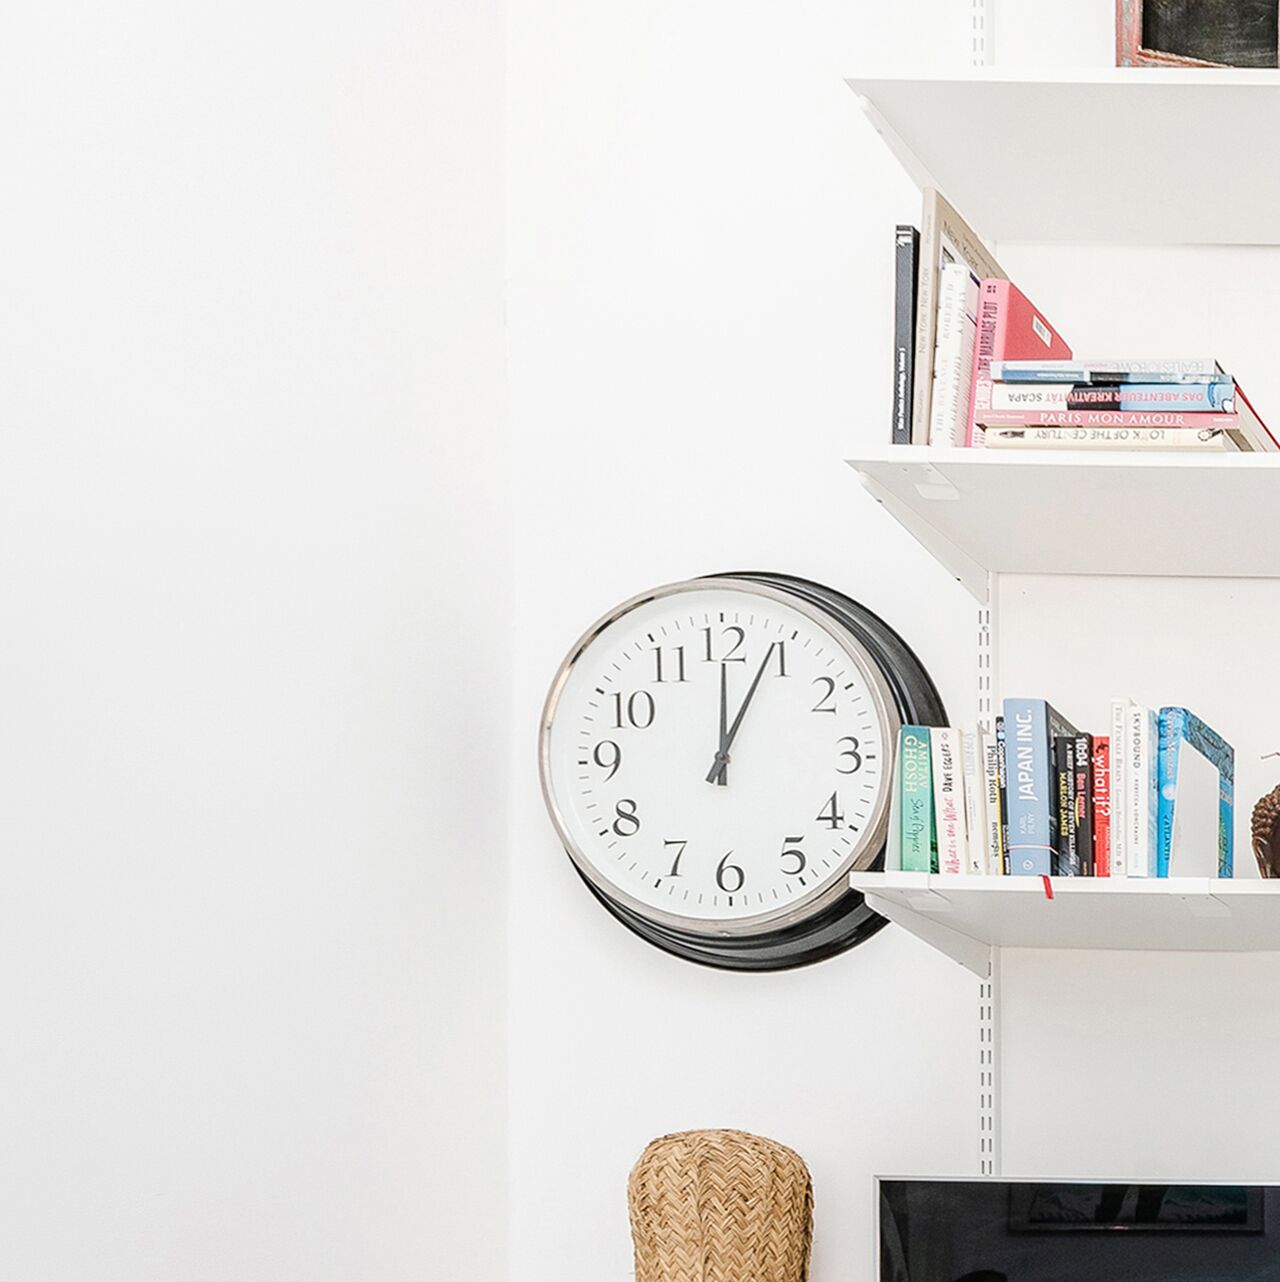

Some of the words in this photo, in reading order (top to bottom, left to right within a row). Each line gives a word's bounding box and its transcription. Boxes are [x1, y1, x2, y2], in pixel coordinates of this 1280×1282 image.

[982, 301, 998, 319] PLOT
[979, 320, 997, 356] MARRIAGE
[1008, 392, 1043, 402] SCAPA
[1115, 391, 1179, 402] ABENTEUER
[1182, 391, 1204, 401] DAS
[1035, 430, 1087, 439] CETURY
[1040, 413, 1081, 422] PARIS
[1088, 413, 1124, 423] MON
[1129, 414, 1185, 424] AMOUR
[1090, 430, 1111, 439] THE
[1132, 430, 1166, 439] LOK
[701, 626, 747, 663] 12
[777, 641, 792, 678] 1
[652, 645, 690, 683] 11
[611, 690, 656, 729] 10
[811, 677, 837, 714] 2
[1015, 709, 1034, 742] INC.
[1133, 713, 1141, 769] SKYBOUND
[594, 740, 622, 781] 9
[835, 736, 862, 774] 3
[904, 735, 918, 793] GHOSH
[918, 741, 928, 788] AMITAV
[940, 743, 953, 771] EGGERS
[986, 745, 998, 777] Philip
[998, 740, 1007, 789] Copenhagen
[1075, 737, 1088, 767] 10:04
[942, 773, 953, 793] DAVE
[1017, 746, 1039, 801] JAPAN
[1059, 772, 1067, 808] MARLON
[1077, 772, 1087, 790] Ben
[1094, 755, 1110, 793] what
[910, 799, 924, 815] Sea
[988, 779, 998, 804] Roth
[1068, 800, 1075, 810] OF
[1077, 791, 1086, 819] Lerner
[1092, 796, 1112, 816] if?
[612, 799, 641, 836] 8
[817, 791, 845, 830] 4
[1060, 808, 1069, 836] JAMES
[663, 839, 688, 878] 7
[716, 849, 745, 893] 6
[780, 836, 807, 876] 5
